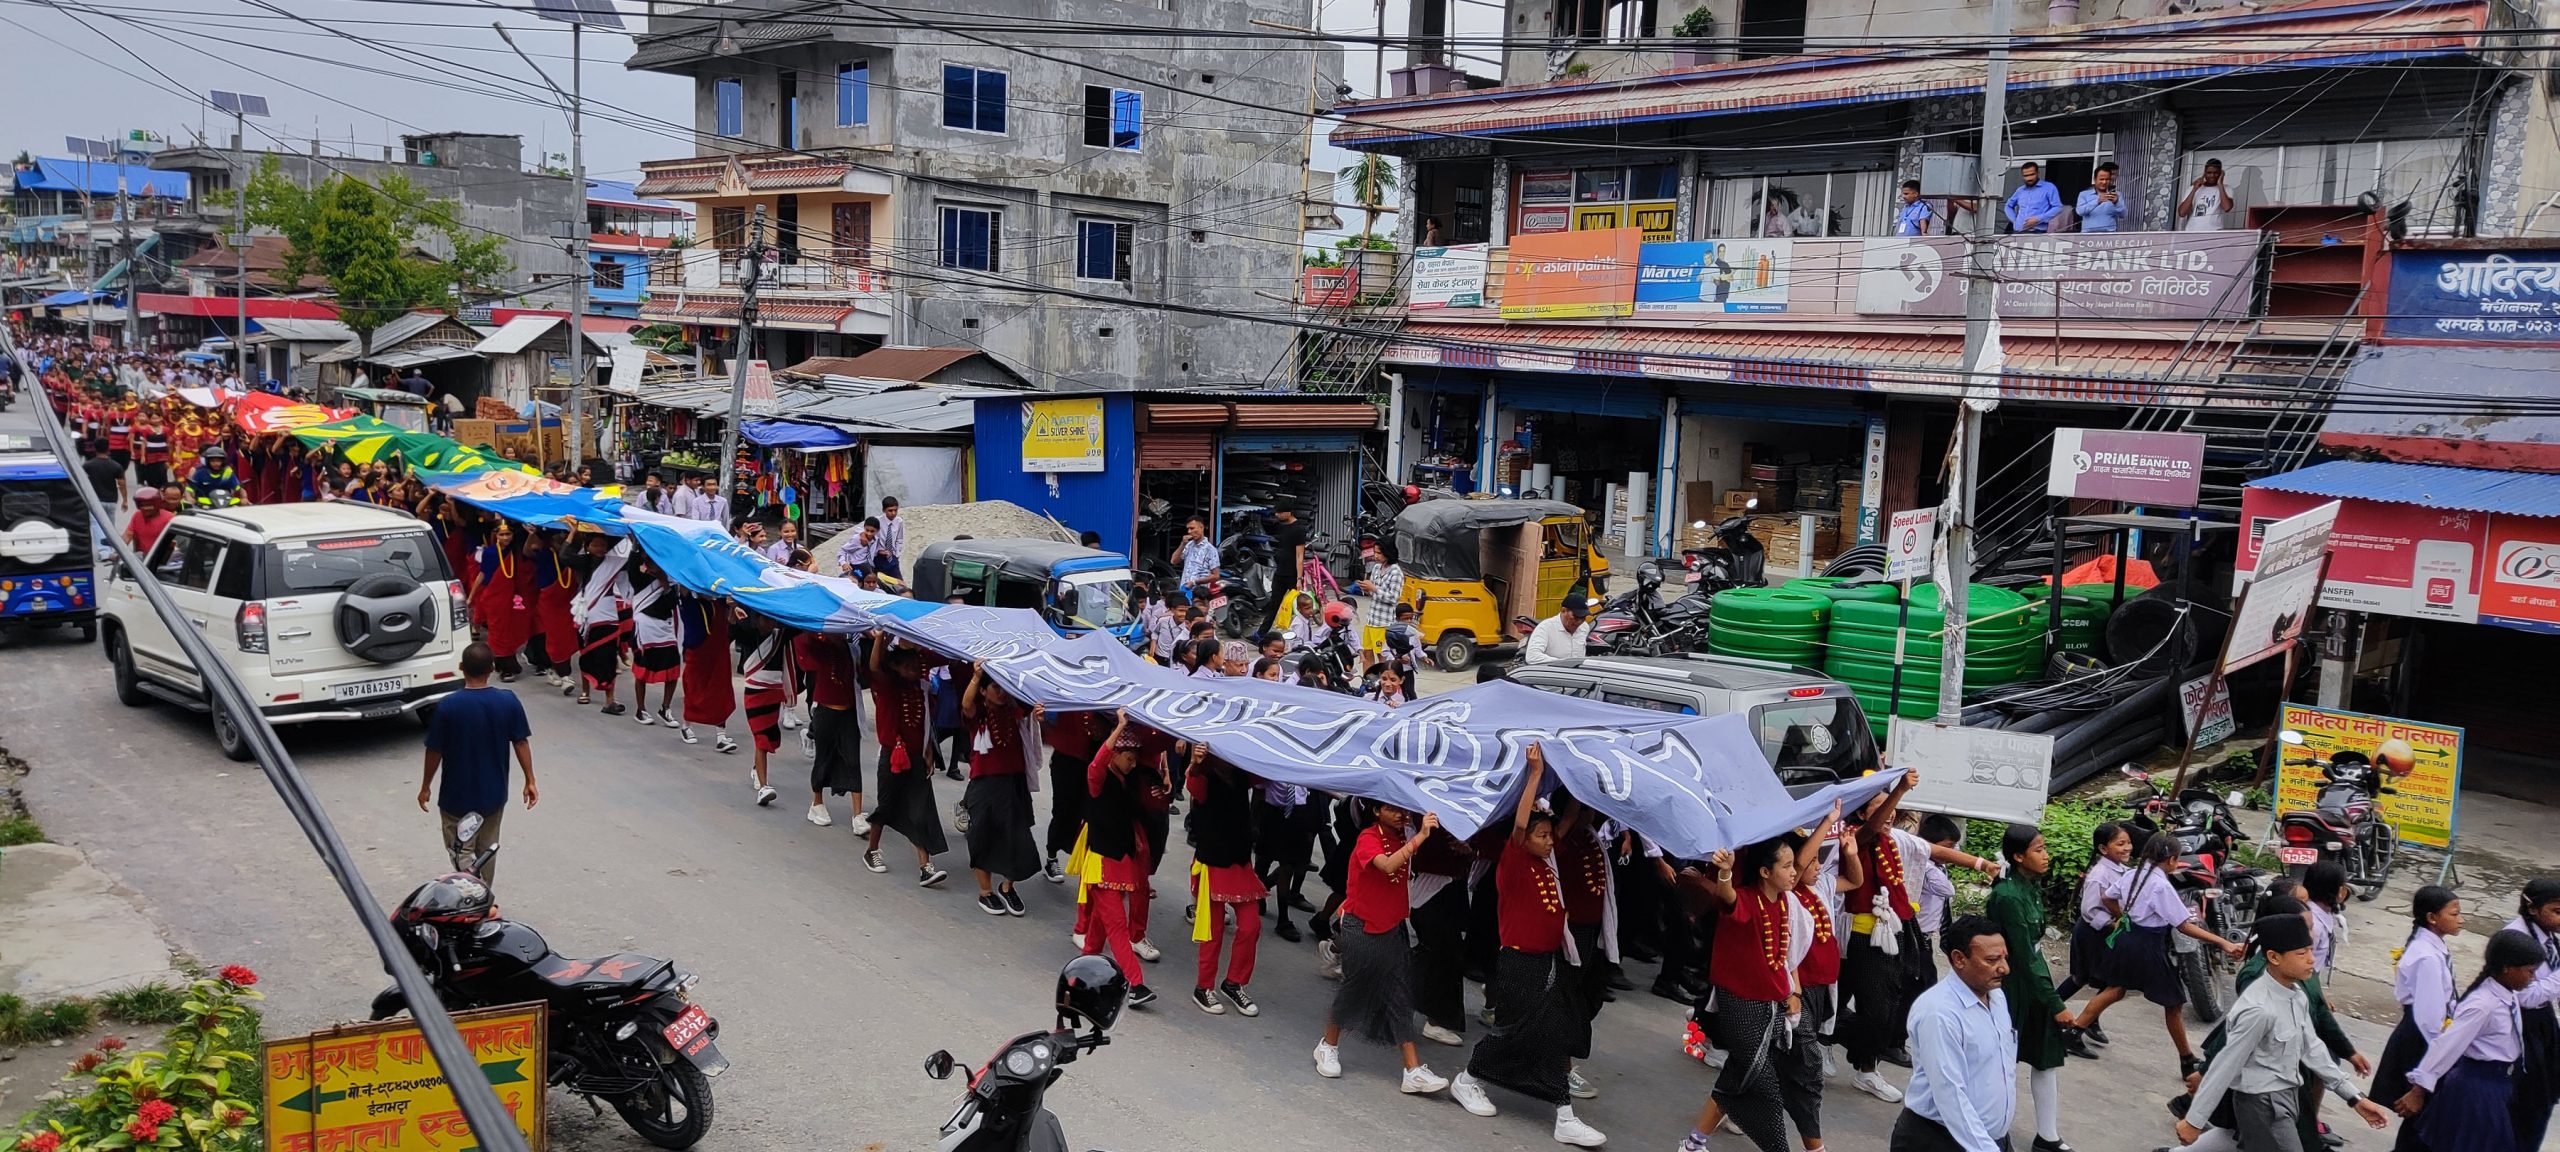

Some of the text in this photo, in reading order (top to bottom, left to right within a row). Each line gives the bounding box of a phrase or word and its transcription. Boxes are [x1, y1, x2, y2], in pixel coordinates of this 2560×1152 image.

[1643, 211, 1670, 229] WU
[2076, 249, 2153, 271] BANK
[2160, 248, 2214, 271] LTD.
[1642, 265, 1693, 278] Marvel
[2140, 459, 2168, 468] BANK
[2171, 460, 2192, 469] LTD.
[1893, 512, 1933, 528] Speed Limit
[1905, 534, 1914, 547] 40
[342, 680, 401, 697] WB74BA2979
[2287, 710, 2349, 731] आदित्य
[2353, 719, 2387, 737] मनी
